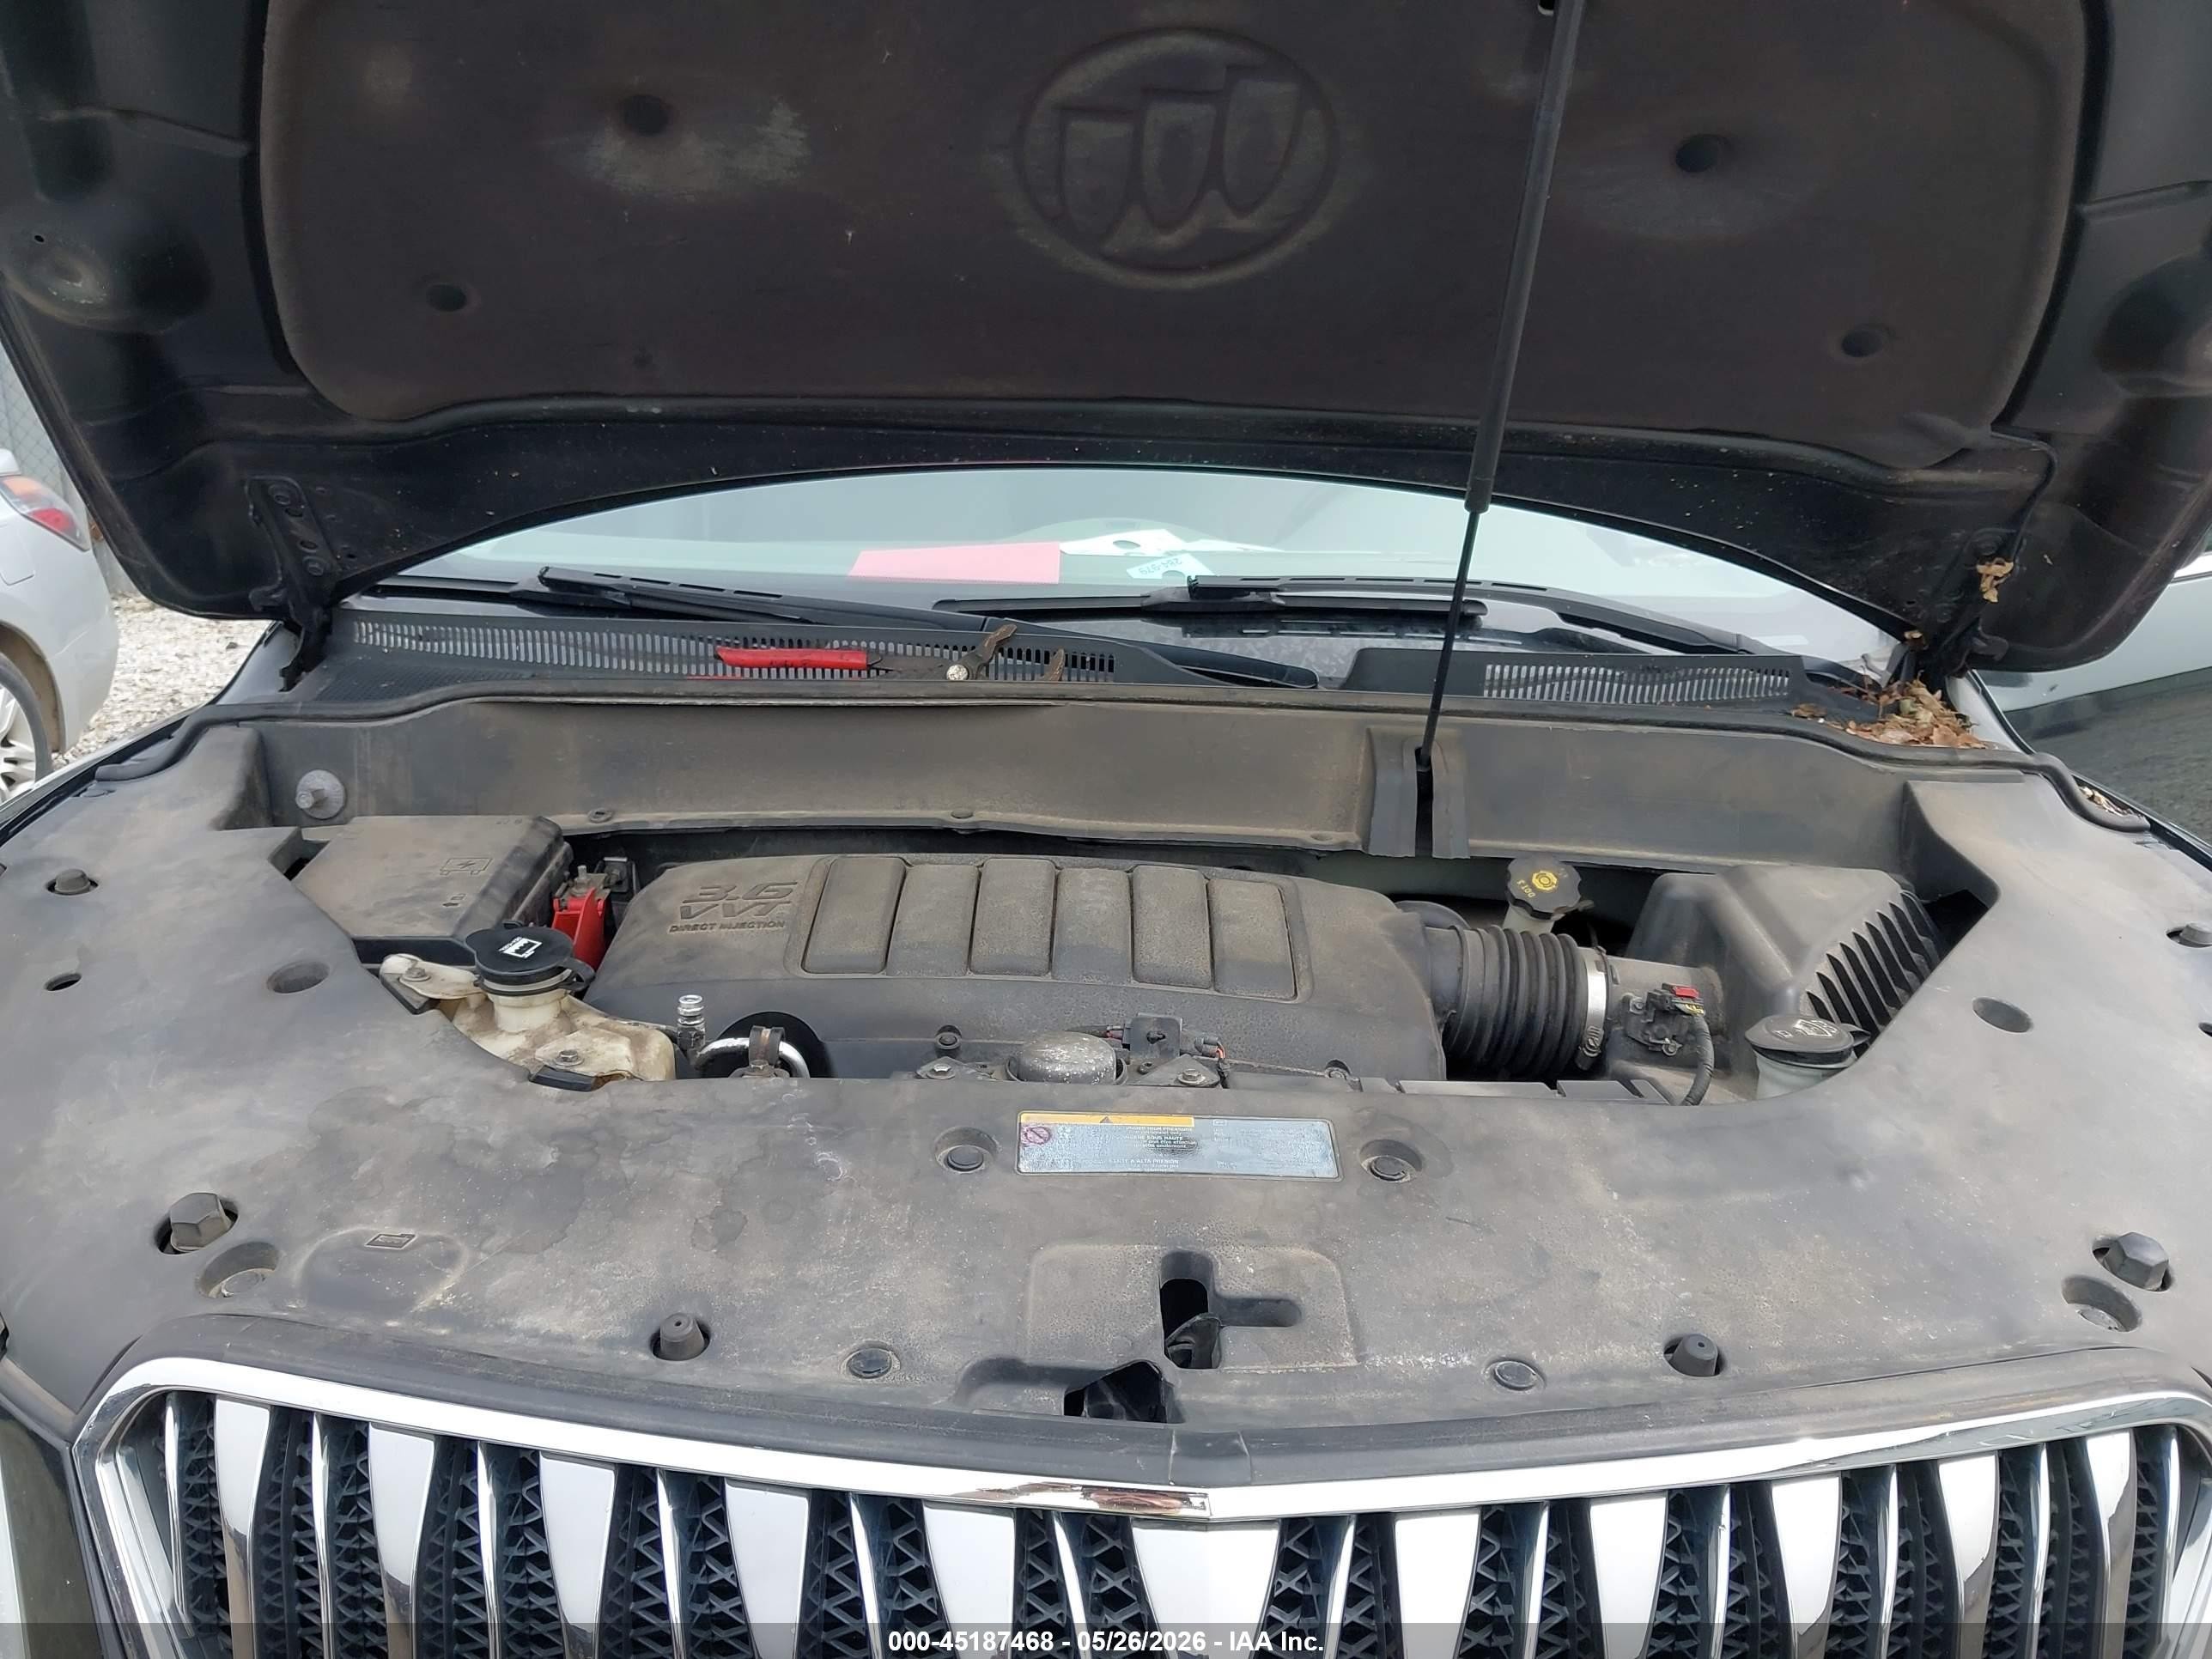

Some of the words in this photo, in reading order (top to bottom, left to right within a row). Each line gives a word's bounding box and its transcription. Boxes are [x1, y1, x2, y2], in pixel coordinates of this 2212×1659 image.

[683, 882, 797, 903] 3.6
[680, 902, 791, 920] VVT
[669, 923, 716, 933] DIRECT
[719, 921, 785, 931] INJECTION
